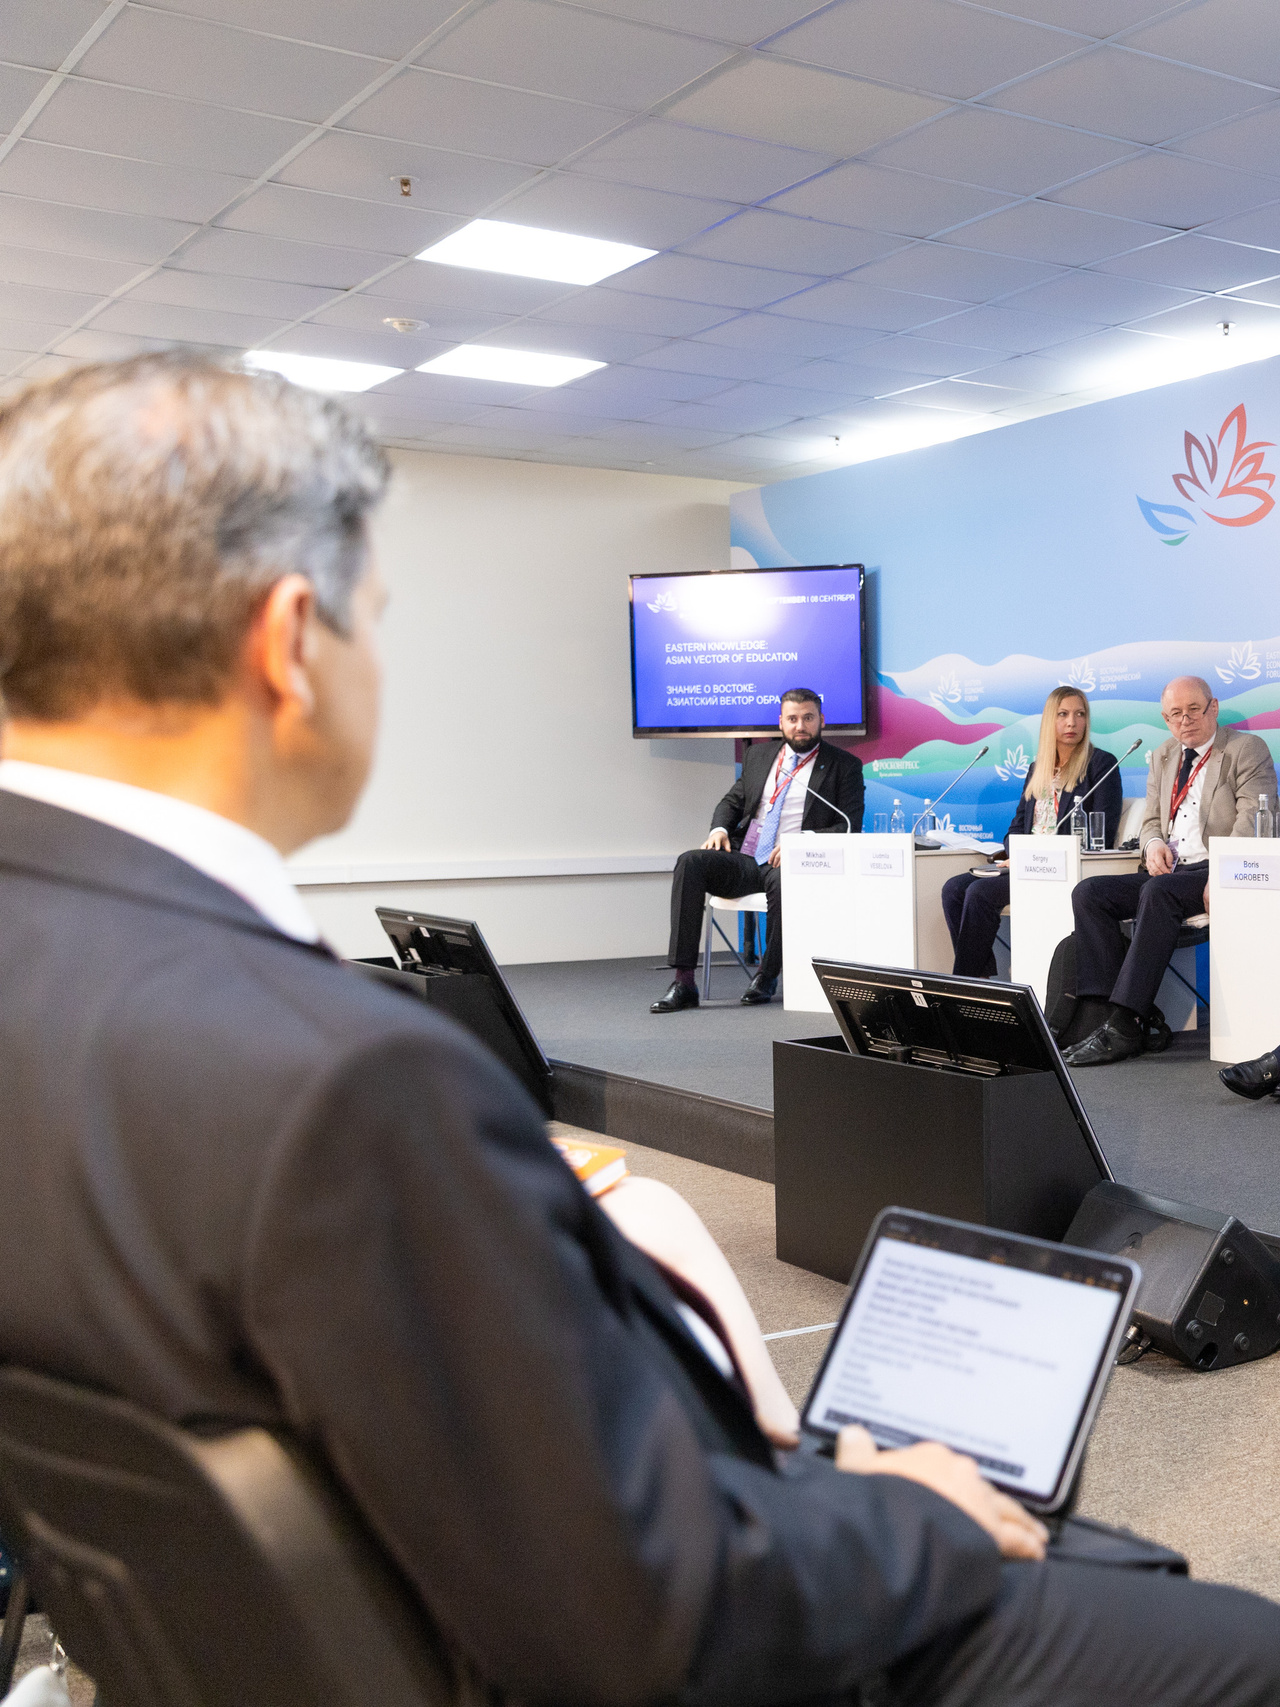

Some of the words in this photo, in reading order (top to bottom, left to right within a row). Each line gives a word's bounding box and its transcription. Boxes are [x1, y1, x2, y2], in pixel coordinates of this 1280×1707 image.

[819, 593, 856, 603] СЕНТЯБРЯ
[665, 642, 707, 653] EASTERN
[707, 640, 769, 652] KNOWLEDGE:
[665, 655, 691, 665] ASIAN
[693, 654, 730, 664] VECTOR
[731, 653, 744, 663] OF
[746, 652, 798, 663] EDUCATION
[666, 684, 702, 695] ЗНАНИЕ
[713, 683, 757, 693] ВОСТОКЕ:
[666, 695, 719, 707] АЗИАТСКИЙ
[720, 696, 755, 706] ВЕКТОР
[805, 851, 826, 859] Mikhail
[1032, 854, 1049, 864] Sergey
[801, 860, 831, 869] KRIVOPAL
[1243, 860, 1260, 869] Boris
[1024, 865, 1058, 875] IVANCHENKO
[1234, 872, 1270, 882] KOROBETS
